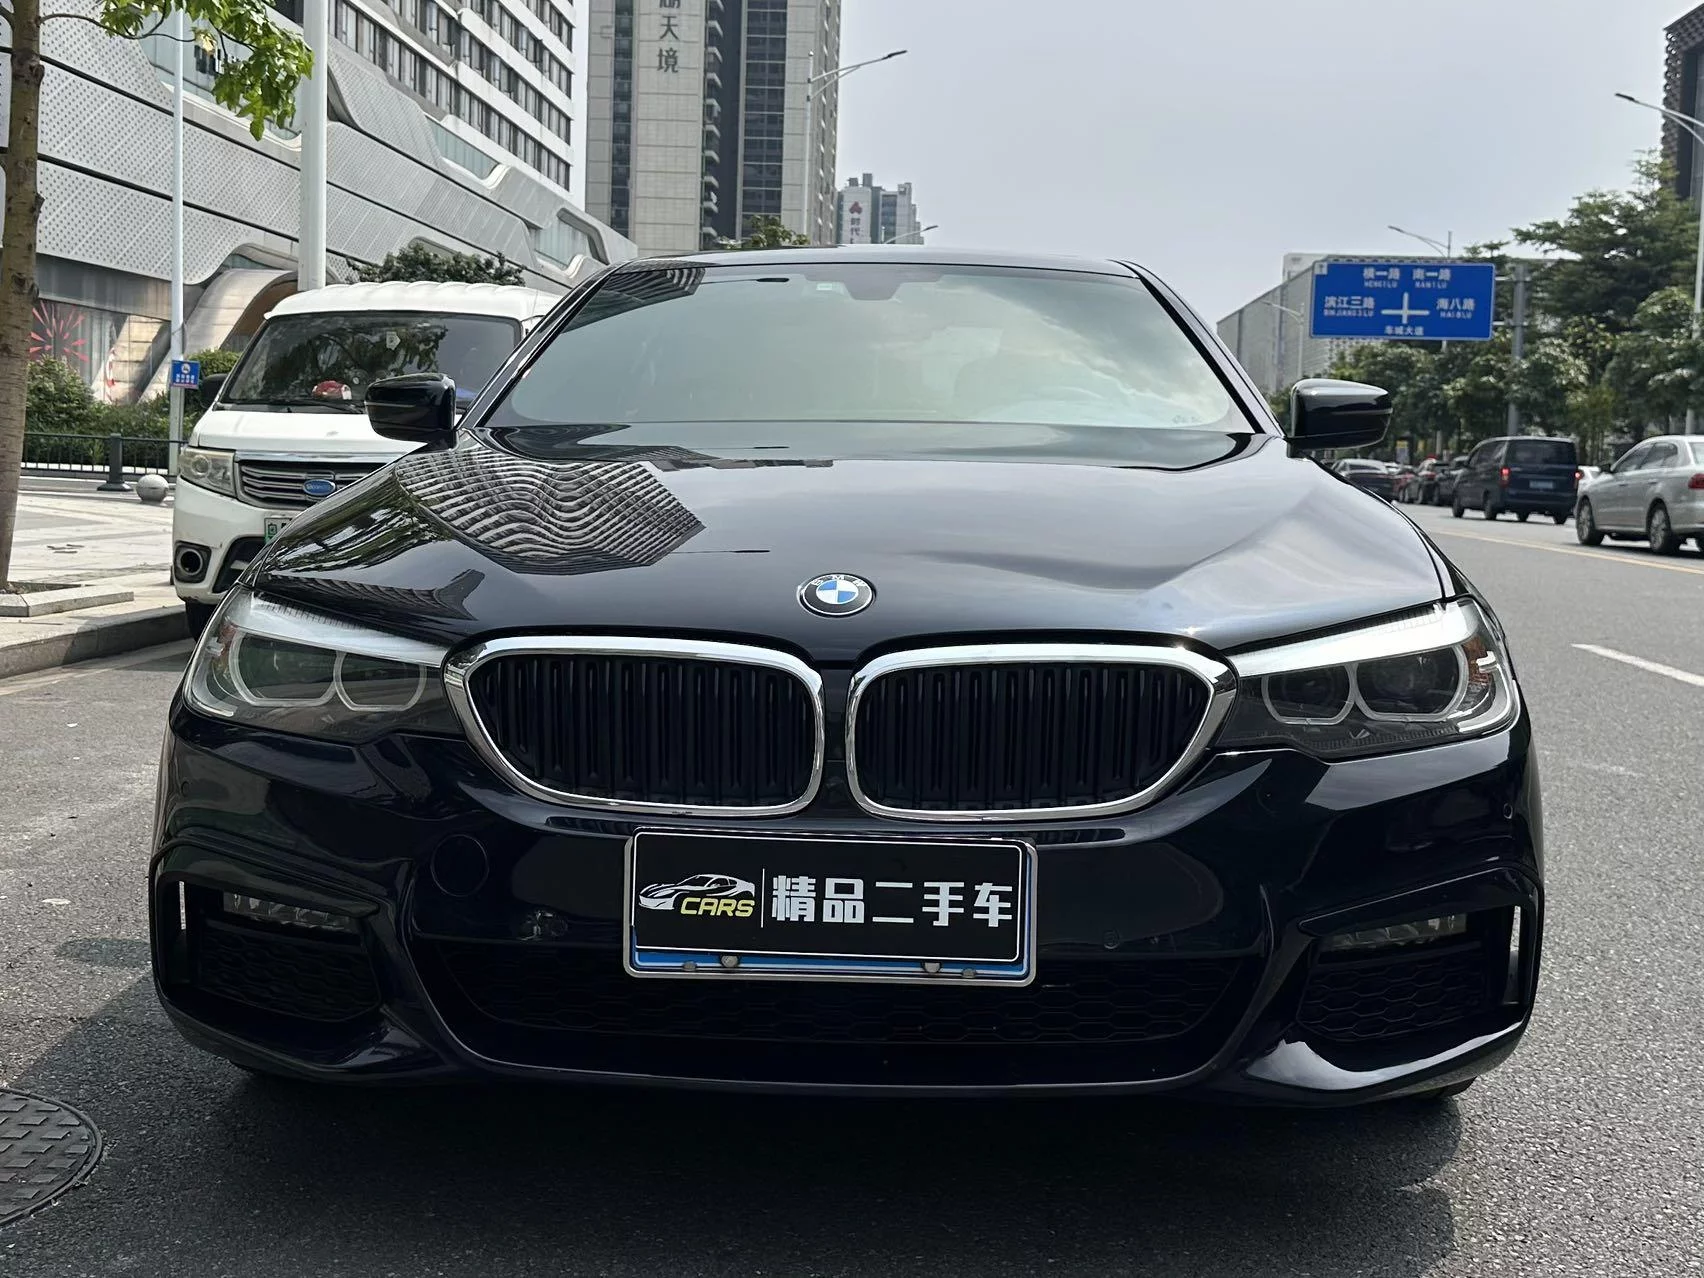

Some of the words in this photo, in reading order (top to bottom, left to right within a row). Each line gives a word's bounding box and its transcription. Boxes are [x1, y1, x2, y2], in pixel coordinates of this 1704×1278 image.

[680, 897, 755, 918] CARS
[771, 875, 1013, 928] 精品二手车
